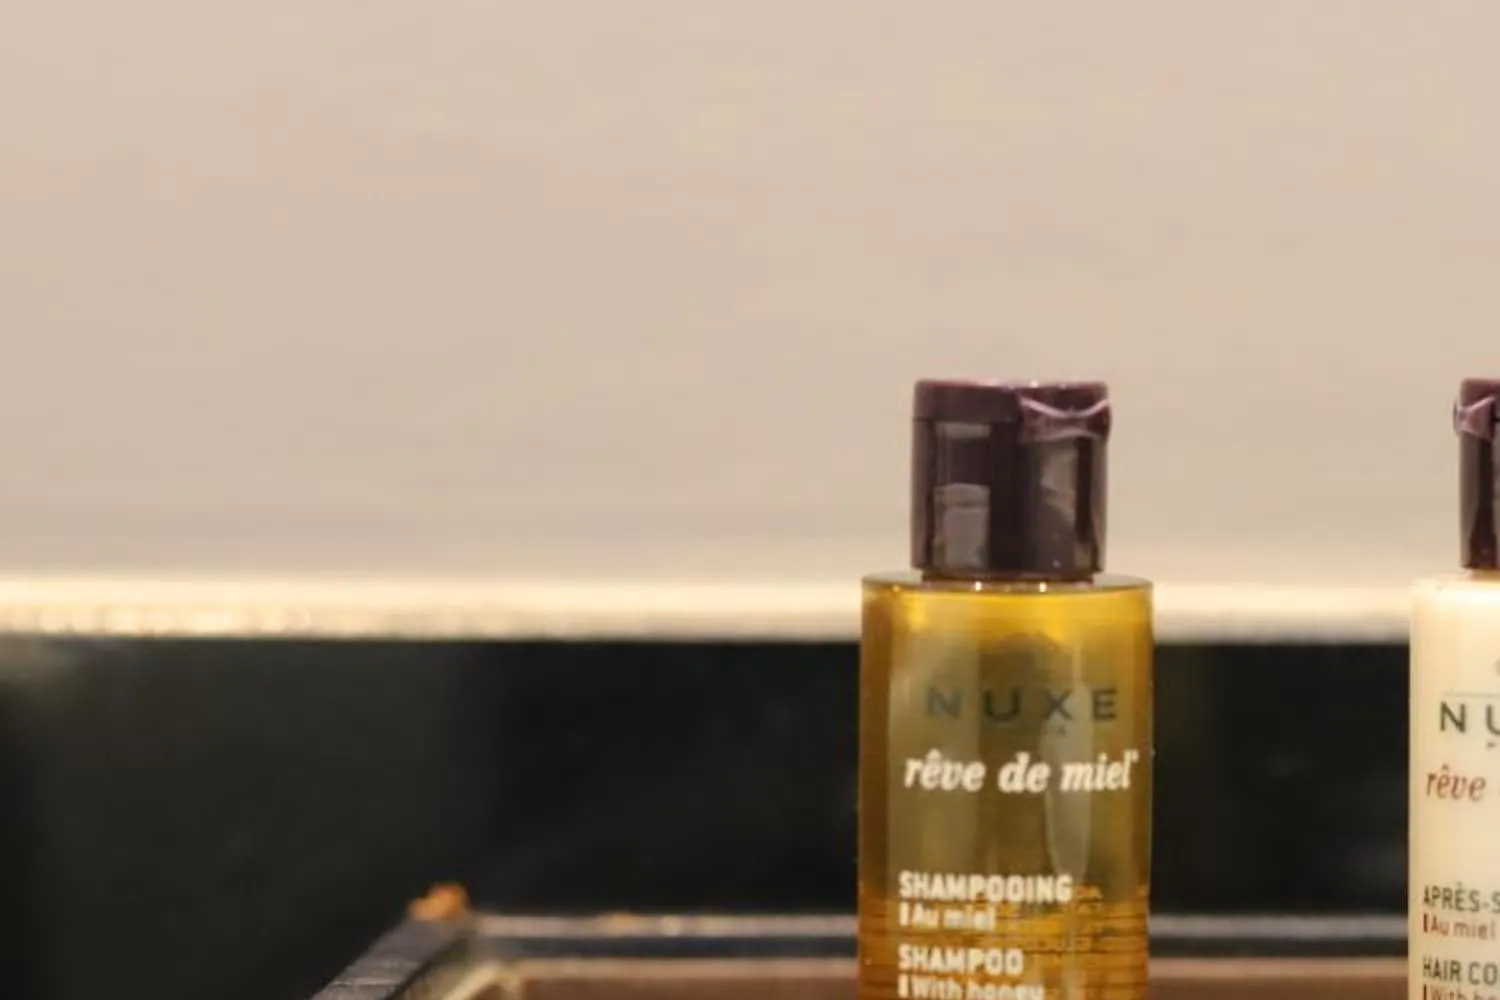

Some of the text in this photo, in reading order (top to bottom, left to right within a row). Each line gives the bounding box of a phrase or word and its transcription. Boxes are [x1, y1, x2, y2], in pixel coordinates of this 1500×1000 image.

[927, 687, 1117, 721] NUXE
[904, 748, 1134, 792] rêve de miel
[1426, 763, 1486, 800] rêve
[898, 869, 1073, 903] SHAMPOOING
[912, 902, 996, 931] Au miel
[1431, 915, 1496, 940] Au miel
[898, 943, 1024, 975] SHAMPOO
[1423, 957, 1461, 982] HAIR
[911, 975, 962, 1000] With
